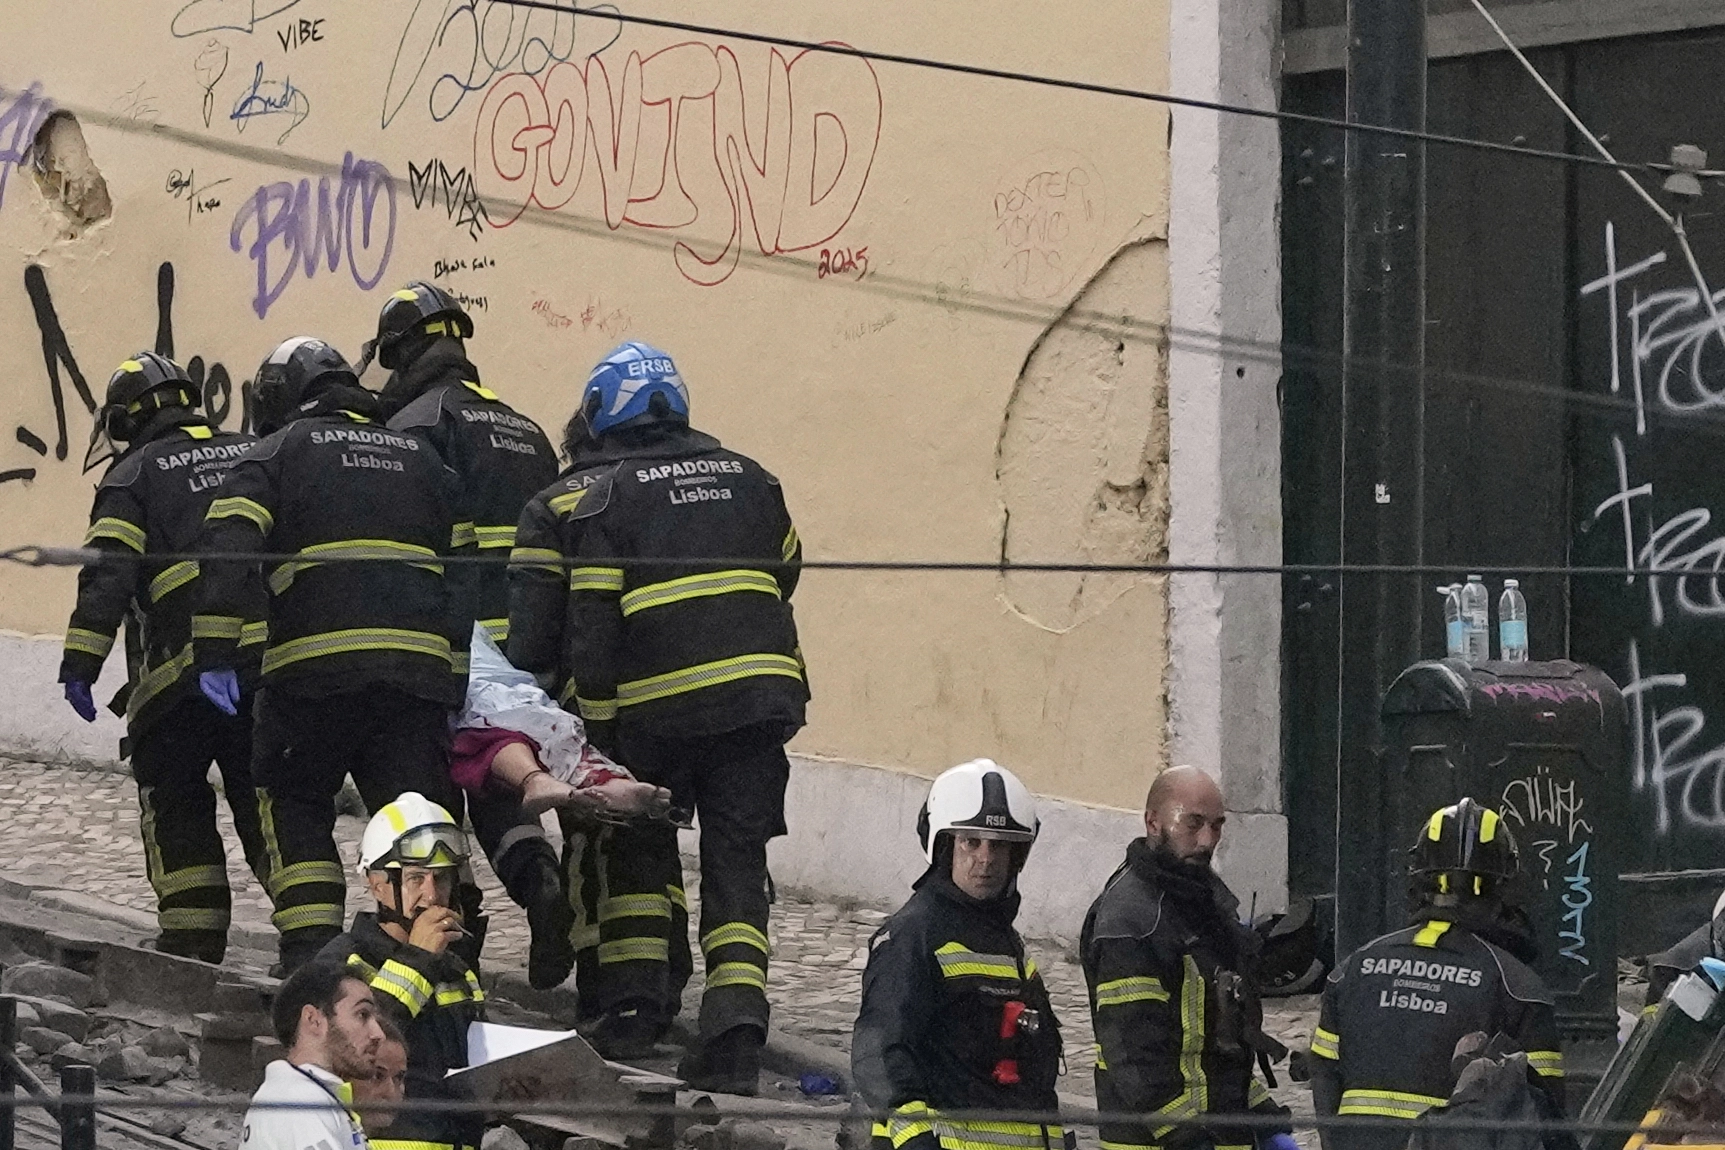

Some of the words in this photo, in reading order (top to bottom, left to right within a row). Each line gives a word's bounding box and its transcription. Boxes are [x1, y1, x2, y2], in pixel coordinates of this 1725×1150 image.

[277, 18, 326, 53] VIBE
[817, 245, 869, 282] 2025
[628, 358, 675, 377] ERSB
[310, 430, 420, 452] SAPADORES
[489, 434, 538, 456] Lisboa
[341, 453, 405, 473] Lisboa
[636, 460, 744, 483] SAPADORES
[669, 486, 733, 505] Lisboa
[985, 814, 1007, 827] RSB
[1360, 957, 1483, 988] SAPADORES
[1380, 990, 1448, 1015] Lisboa
